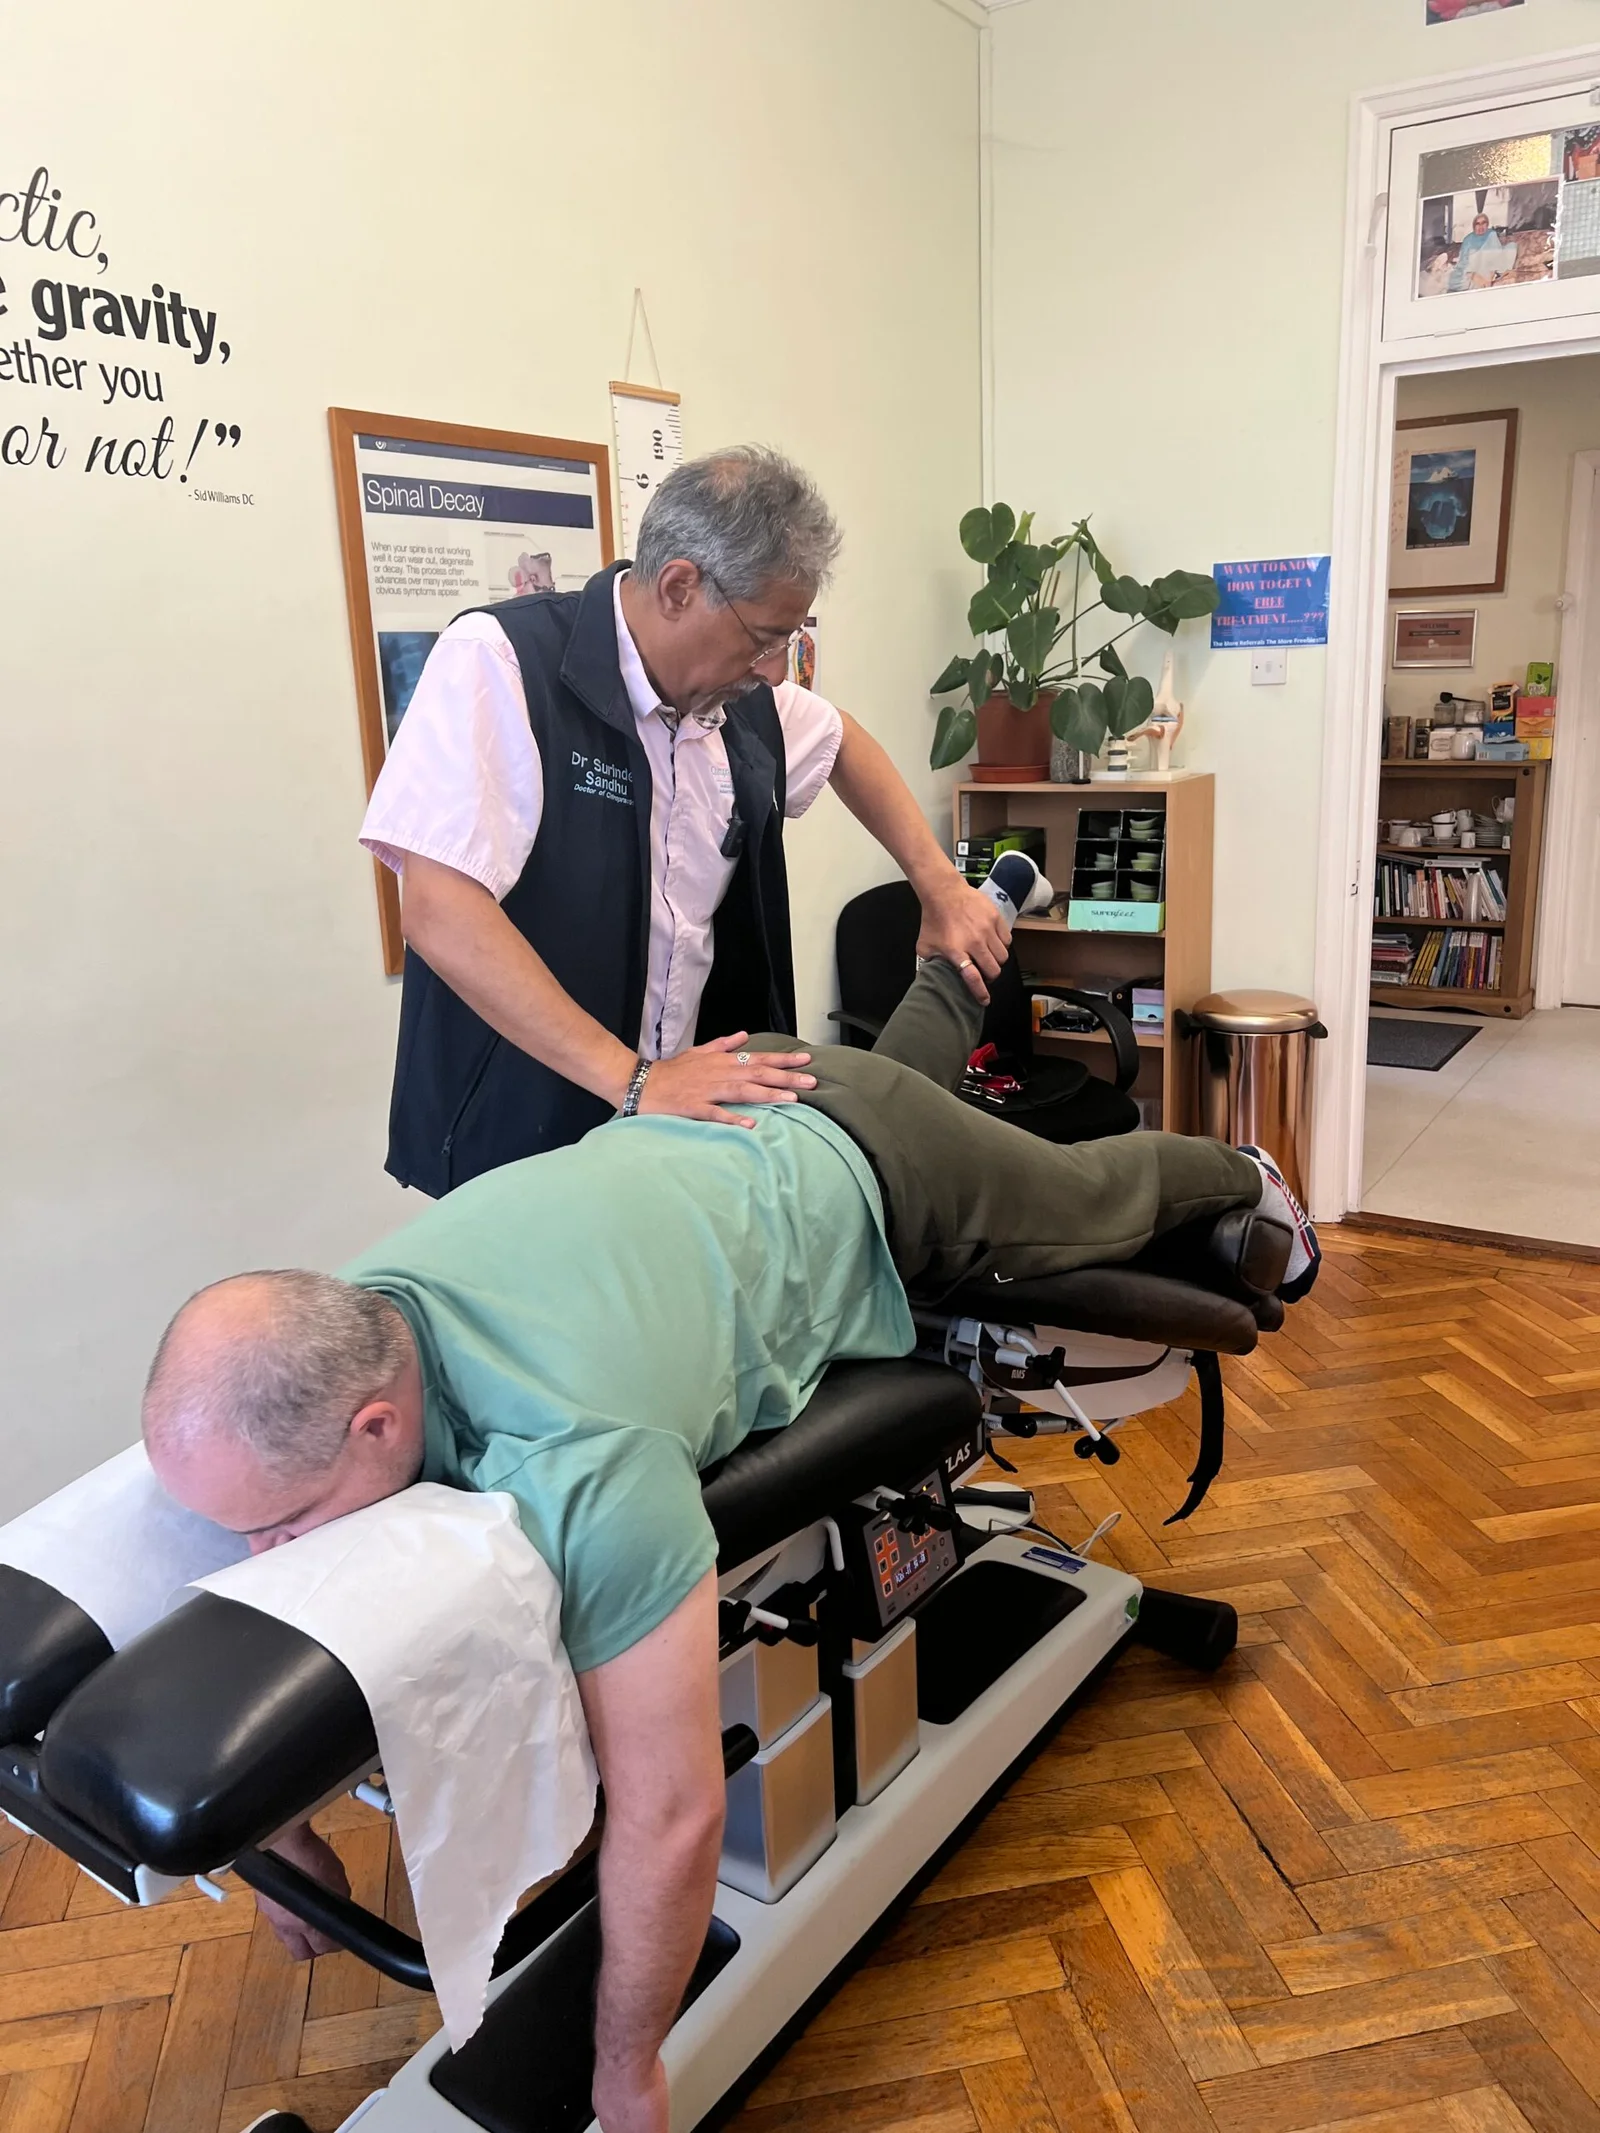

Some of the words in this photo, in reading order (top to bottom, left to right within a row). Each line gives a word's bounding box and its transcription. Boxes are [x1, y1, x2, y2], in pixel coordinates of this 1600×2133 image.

[31, 278, 231, 365] gravity,
[98, 363, 164, 405] you
[1, 416, 67, 469] or
[193, 489, 207, 502] Sid
[207, 490, 241, 504] Williams
[241, 493, 255, 506] DC
[366, 479, 424, 512] Spinal
[429, 485, 485, 518] Decay
[371, 542, 392, 552] When
[393, 544, 407, 554] your
[409, 545, 426, 555] spine
[427, 546, 433, 554] is
[434, 546, 445, 555] not
[446, 546, 471, 558] working
[372, 553, 386, 562] well
[387, 554, 392, 562] it
[408, 556, 424, 564] wear
[439, 557, 474, 567] degenerate
[1223, 563, 1258, 575] WANT
[1262, 562, 1278, 573] TO
[1279, 559, 1319, 572] KNOW
[373, 565, 381, 573] or
[406, 564, 420, 574] This
[421, 567, 447, 577] process
[448, 567, 465, 576] often
[374, 576, 407, 585] advances
[407, 577, 422, 585] over
[422, 578, 440, 588] many
[441, 579, 459, 588] years
[459, 578, 479, 587] before
[1227, 580, 1255, 592] HOW
[1260, 579, 1276, 590] TO
[1277, 577, 1303, 589] GET
[1304, 577, 1312, 588] A
[376, 586, 402, 595] obvious
[402, 587, 437, 597] symptoms
[1254, 595, 1285, 609] FREE
[1266, 638, 1277, 646] The
[1277, 637, 1293, 645] More
[571, 750, 589, 768] Dr
[573, 783, 597, 795] Doctor
[598, 790, 607, 798] of
[585, 770, 628, 796] Sandhu
